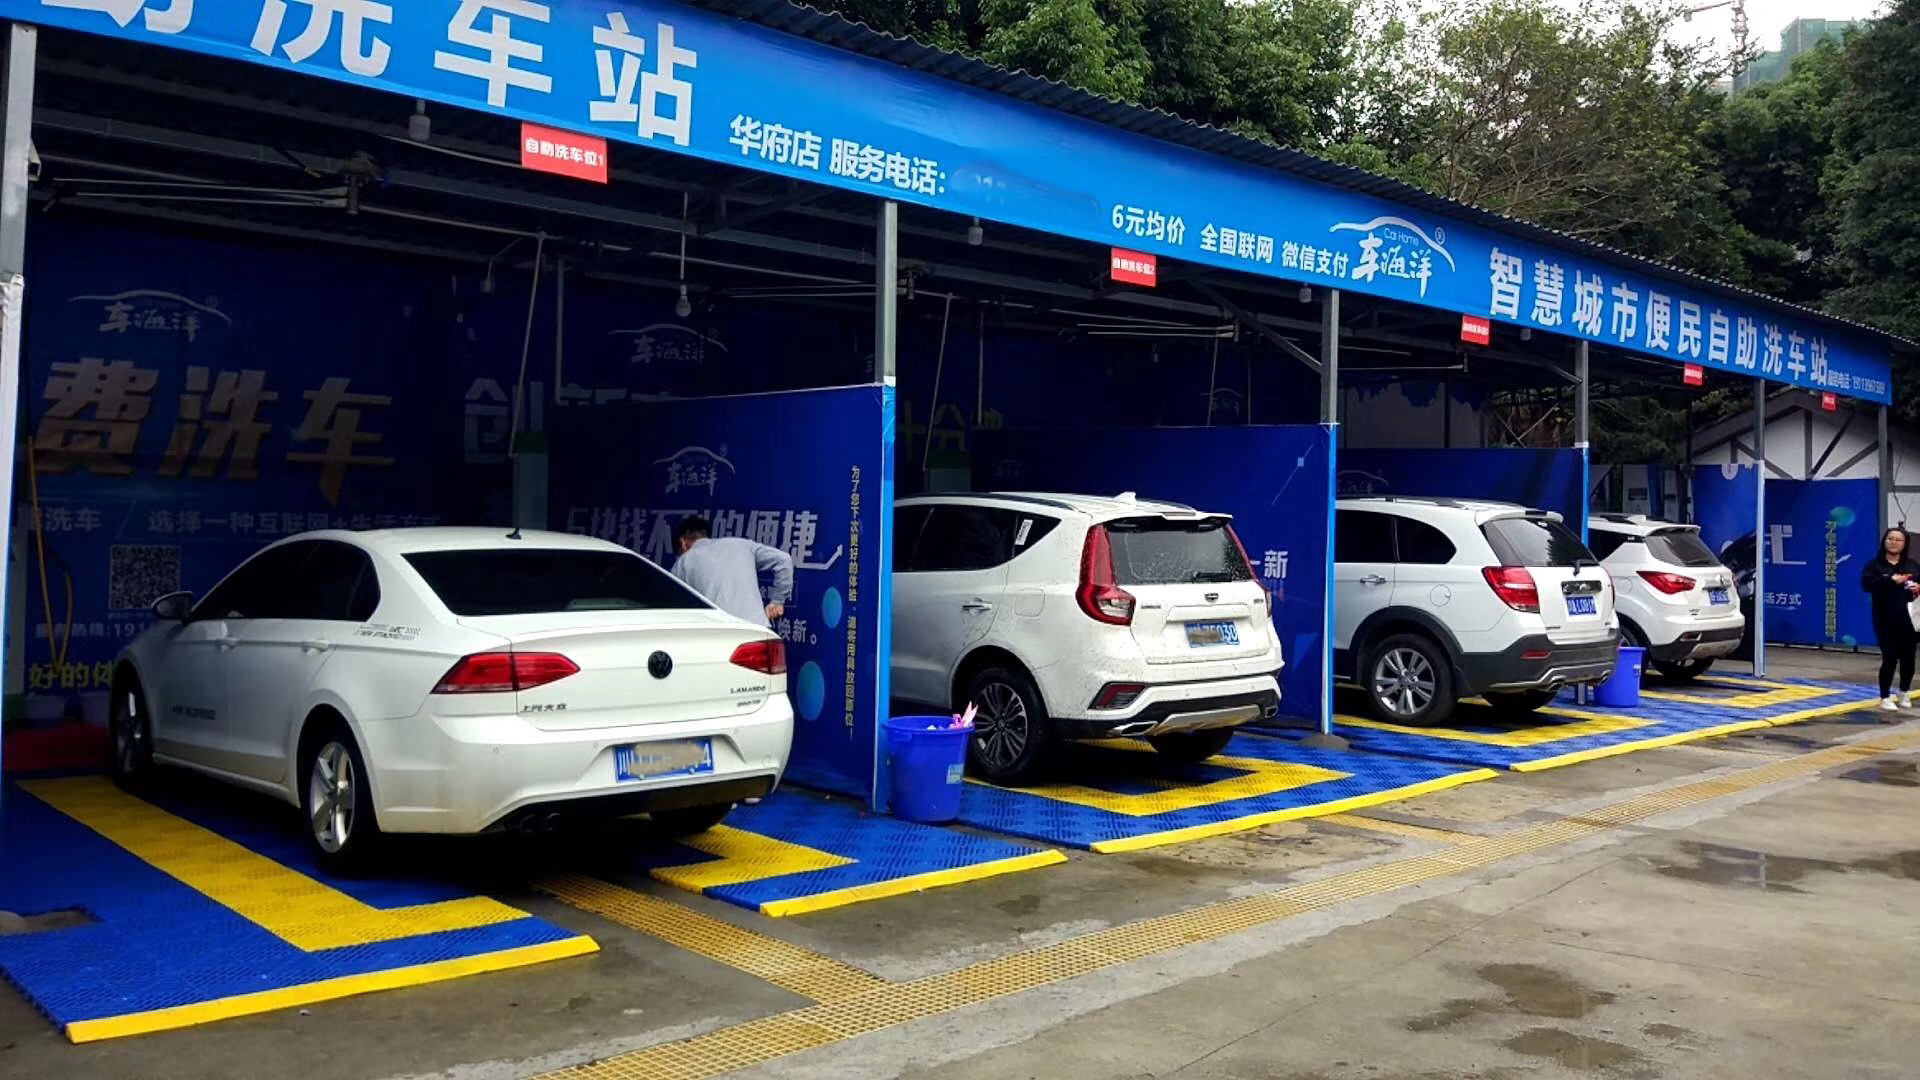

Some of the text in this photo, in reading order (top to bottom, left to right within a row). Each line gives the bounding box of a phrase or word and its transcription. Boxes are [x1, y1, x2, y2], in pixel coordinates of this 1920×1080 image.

[729, 113, 946, 195] 华府店 服务电话:
[1112, 203, 1349, 279] 6元均价 全国联网 微信支付
[1488, 245, 1828, 388] 智慧城市便民自助洗车站
[31, 506, 102, 532] 洗车
